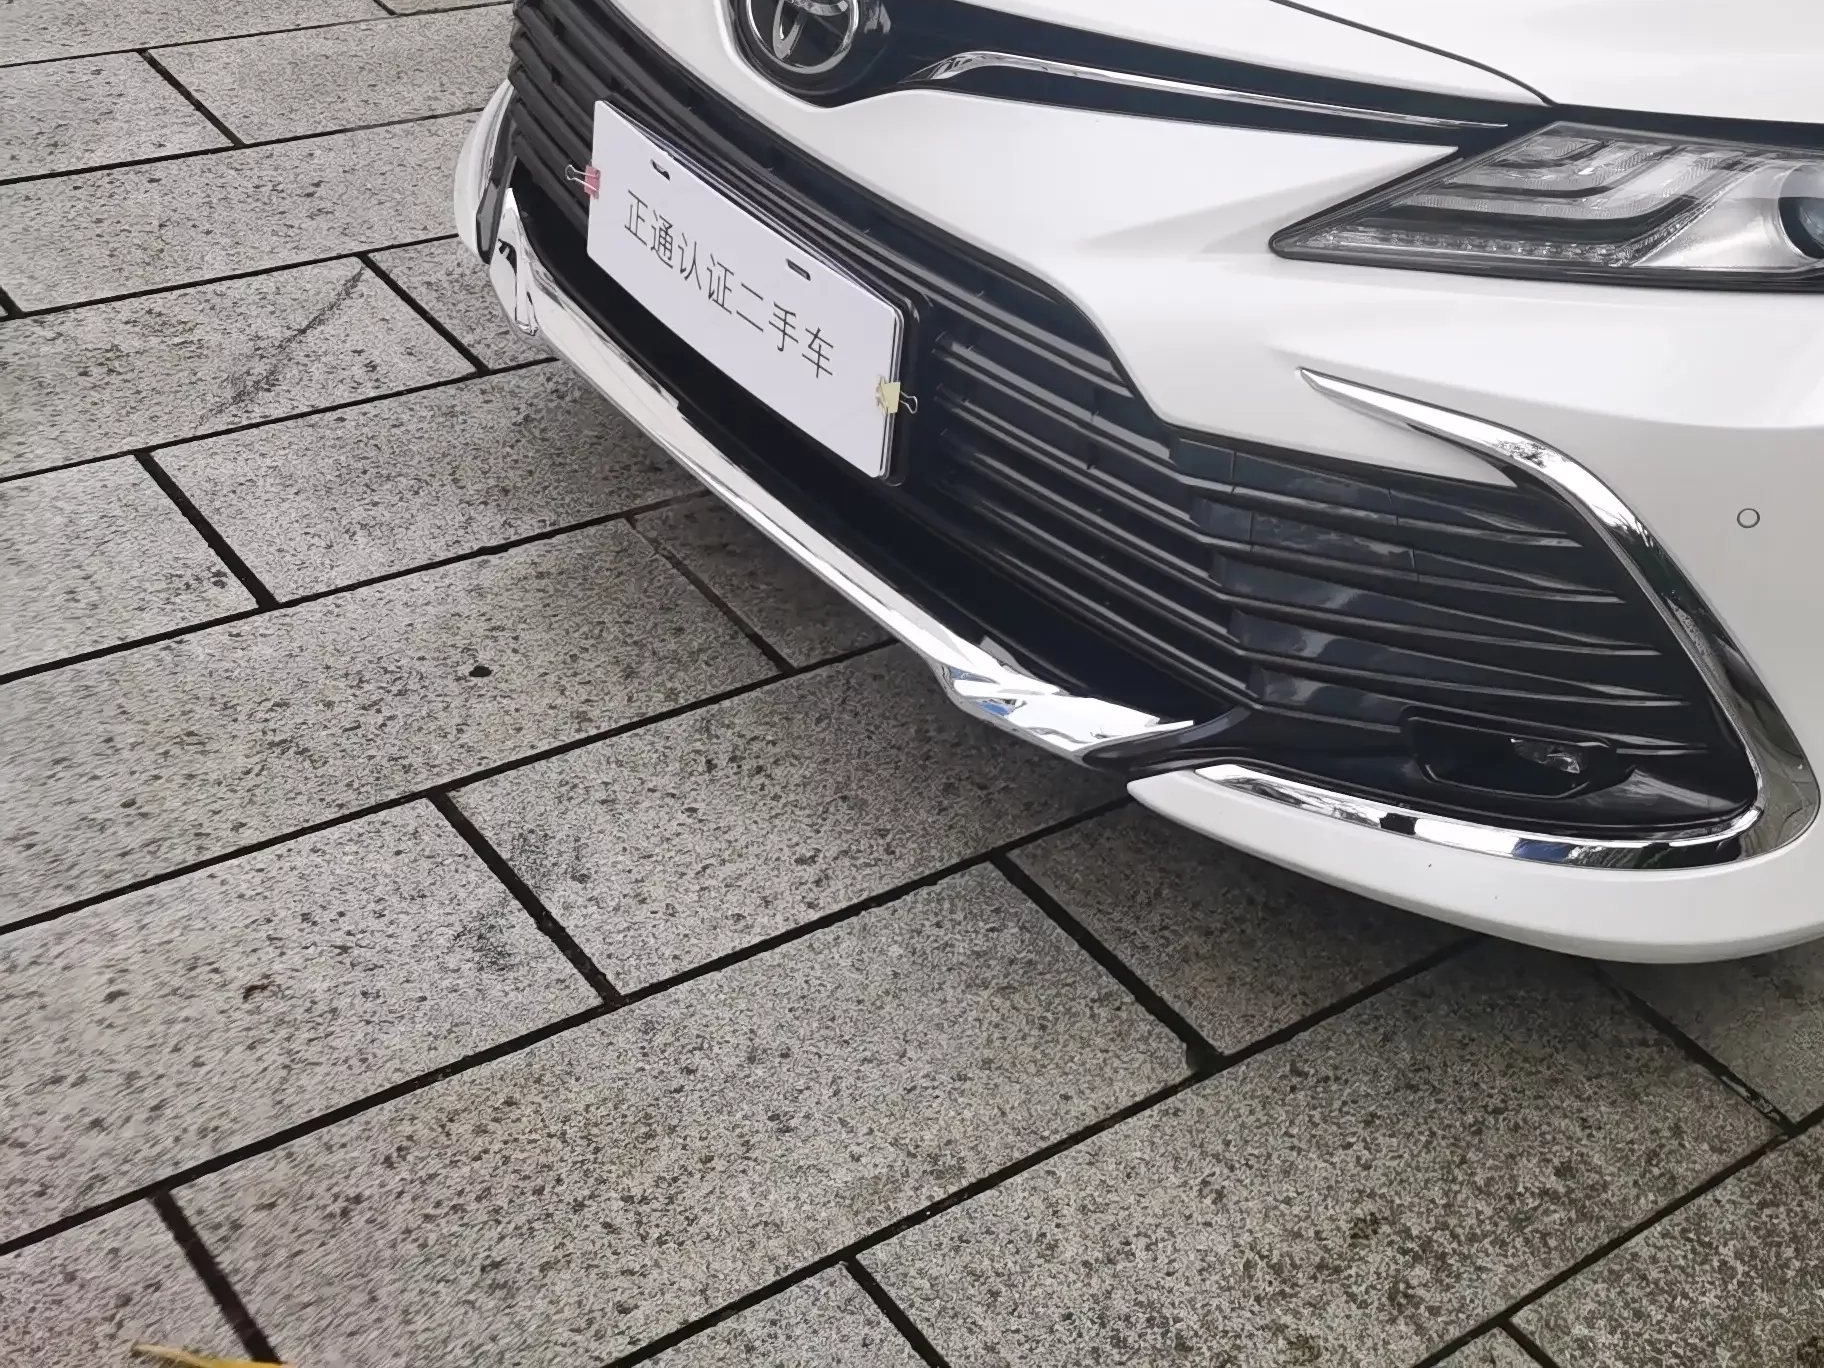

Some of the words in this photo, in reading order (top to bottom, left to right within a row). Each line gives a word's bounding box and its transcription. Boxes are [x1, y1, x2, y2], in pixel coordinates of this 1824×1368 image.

[624, 189, 835, 380] 正通认证二手车
